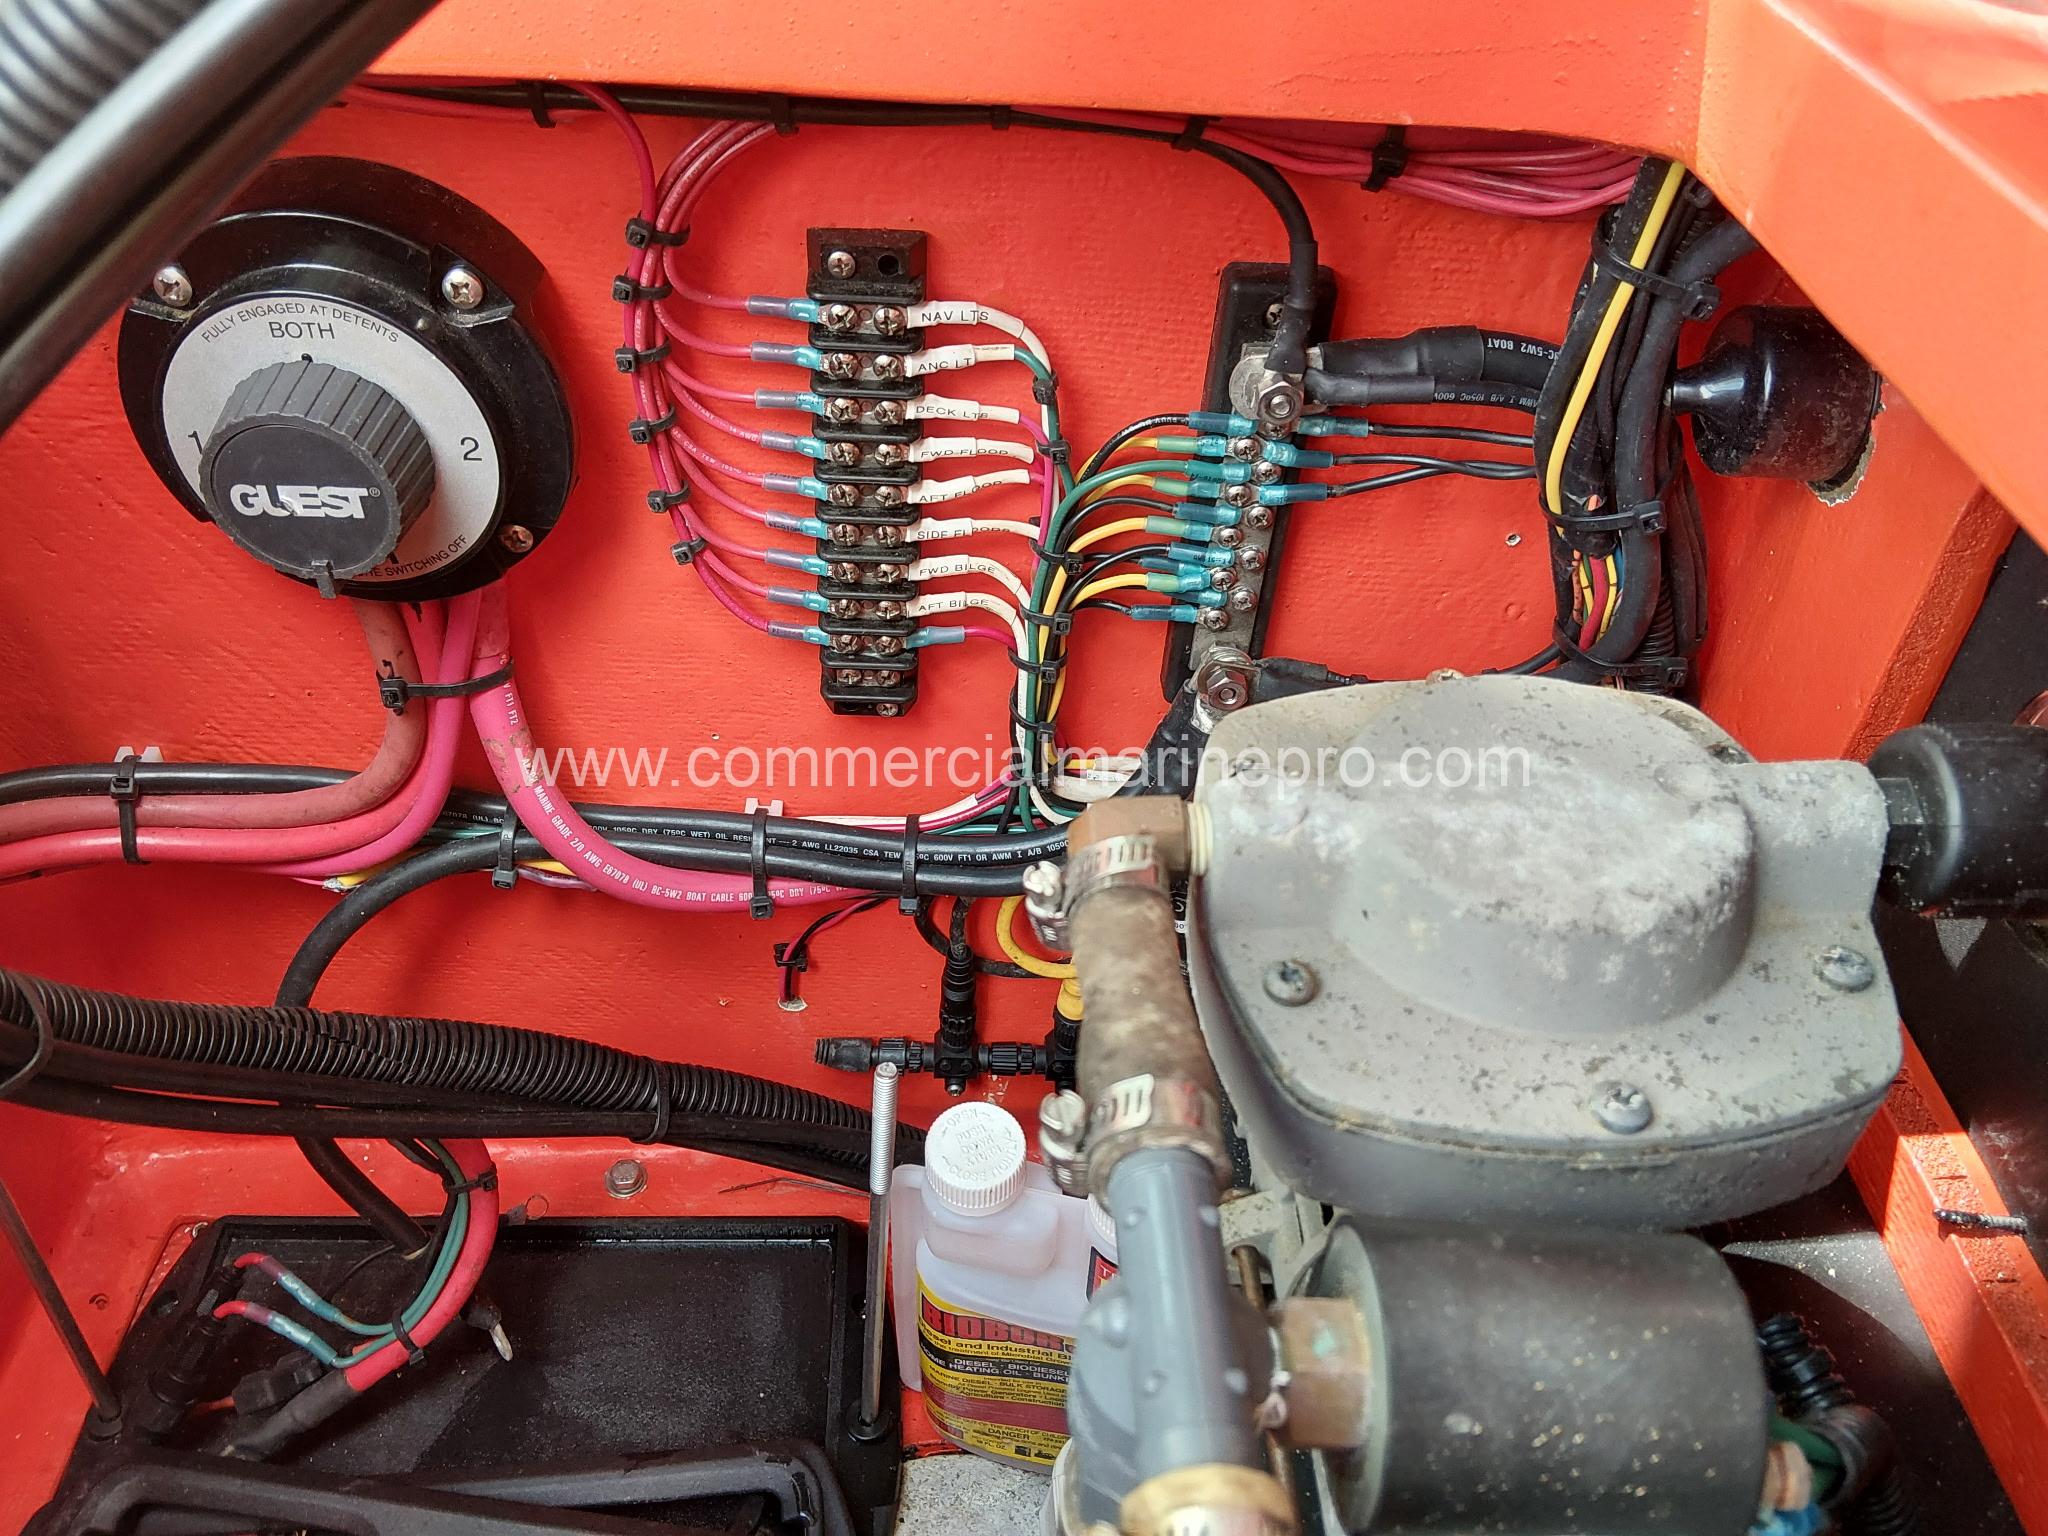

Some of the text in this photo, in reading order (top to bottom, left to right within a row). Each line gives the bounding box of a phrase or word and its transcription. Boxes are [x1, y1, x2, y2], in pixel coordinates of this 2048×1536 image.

[200, 302, 399, 343] FULLY ENGAGED AT DETENTS
[921, 310, 989, 322] NAV LTS
[268, 321, 335, 339] BOTH
[1487, 338, 1514, 350] BOAT
[918, 357, 972, 372] ANC LT
[916, 405, 956, 416] DECK
[187, 430, 203, 455] 1
[460, 436, 483, 462] 2
[920, 448, 1009, 458] FWD FLOOD
[919, 481, 1003, 503] AFT FLOOD
[230, 483, 369, 519] GUEST
[917, 530, 949, 540] SIDE
[385, 549, 449, 577] SWITCHING
[447, 534, 467, 553] OFF
[919, 563, 996, 576] FWD BILGE
[919, 599, 989, 612] AFT BILGE
[508, 710, 519, 726] FT2
[533, 785, 556, 816] MARINE
[551, 814, 573, 840] GRADE
[569, 837, 585, 853] 2/0
[583, 850, 603, 868] AWG
[651, 886, 682, 900] BC-5W2
[687, 892, 706, 901] BOAT
[711, 893, 734, 902] CABLE
[690, 831, 711, 839] WET)
[802, 841, 820, 849] AWG
[824, 843, 858, 855] LL22035
[863, 848, 879, 857] CSA
[883, 850, 901, 859] TEW
[933, 853, 953, 861] 600V
[992, 852, 1012, 861] AWM
[1027, 847, 1042, 857] A/B
[956, 1342, 982, 1350] and
[987, 1343, 1053, 1357] Industrial
[949, 1363, 999, 1374] HEATING
[954, 1359, 995, 1368] DIESEL
[1008, 1363, 1070, 1377] BIODIESEL
[987, 1428, 1030, 1440] DANGER
